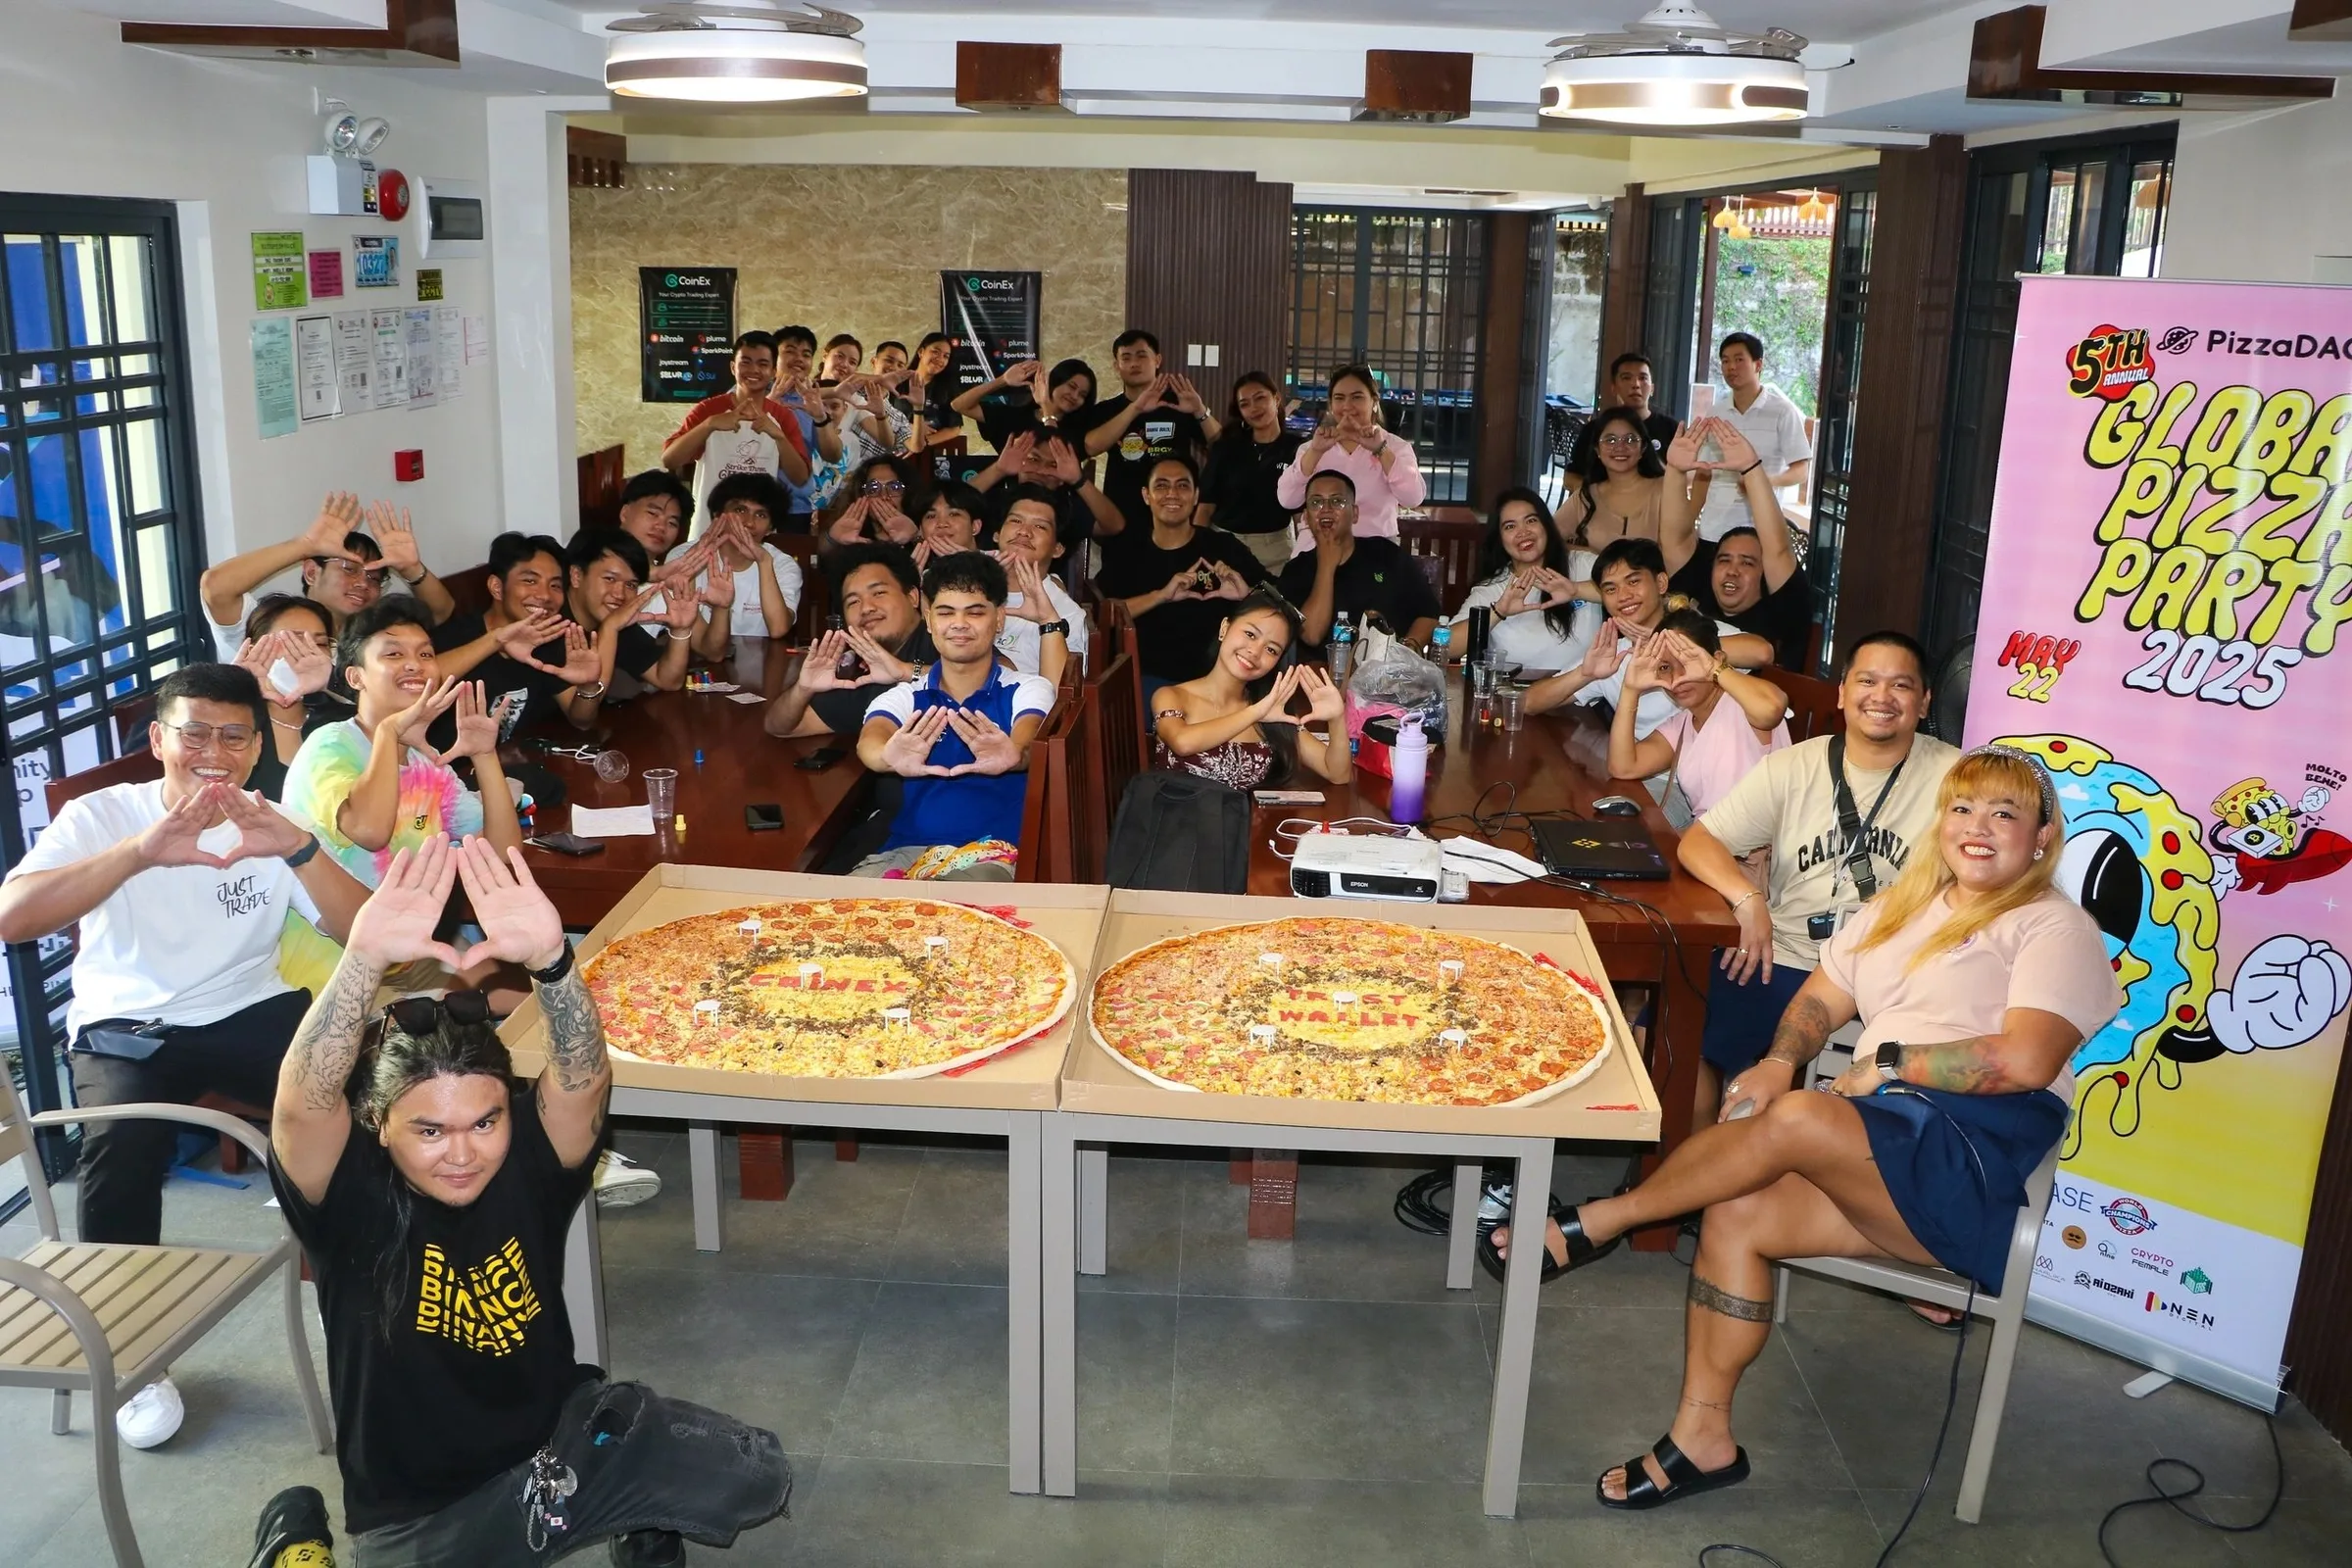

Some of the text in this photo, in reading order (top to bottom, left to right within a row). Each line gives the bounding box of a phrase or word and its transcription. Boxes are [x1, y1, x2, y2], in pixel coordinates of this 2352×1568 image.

[678, 275, 711, 286] CoinEx
[981, 279, 1014, 290] CoinEx
[660, 334, 684, 343] bitcoin
[1007, 339, 1029, 348] plume
[2068, 329, 2149, 397] 5TH
[2102, 368, 2149, 387] ANNUAL
[2083, 380, 2352, 485] GLOBA
[1998, 630, 2082, 676] MAY
[2123, 630, 2302, 710] 2025
[2007, 662, 2050, 704] 22
[2305, 773, 2341, 791] BENE!
[2306, 763, 2347, 782] MOLTO
[217, 875, 256, 903] JUST
[220, 888, 270, 918] TRADE
[1286, 985, 1407, 1006] TRST
[1279, 1010, 1420, 1028] WALLET
[2052, 1182, 2094, 1214] ASE
[2119, 1198, 2143, 1210] WORLD
[2105, 1209, 2151, 1229] CHAMPIONS
[2116, 1224, 2137, 1235] PIZZA
[2131, 1248, 2174, 1268] CRYPTO
[2132, 1258, 2170, 1276] FEMALE
